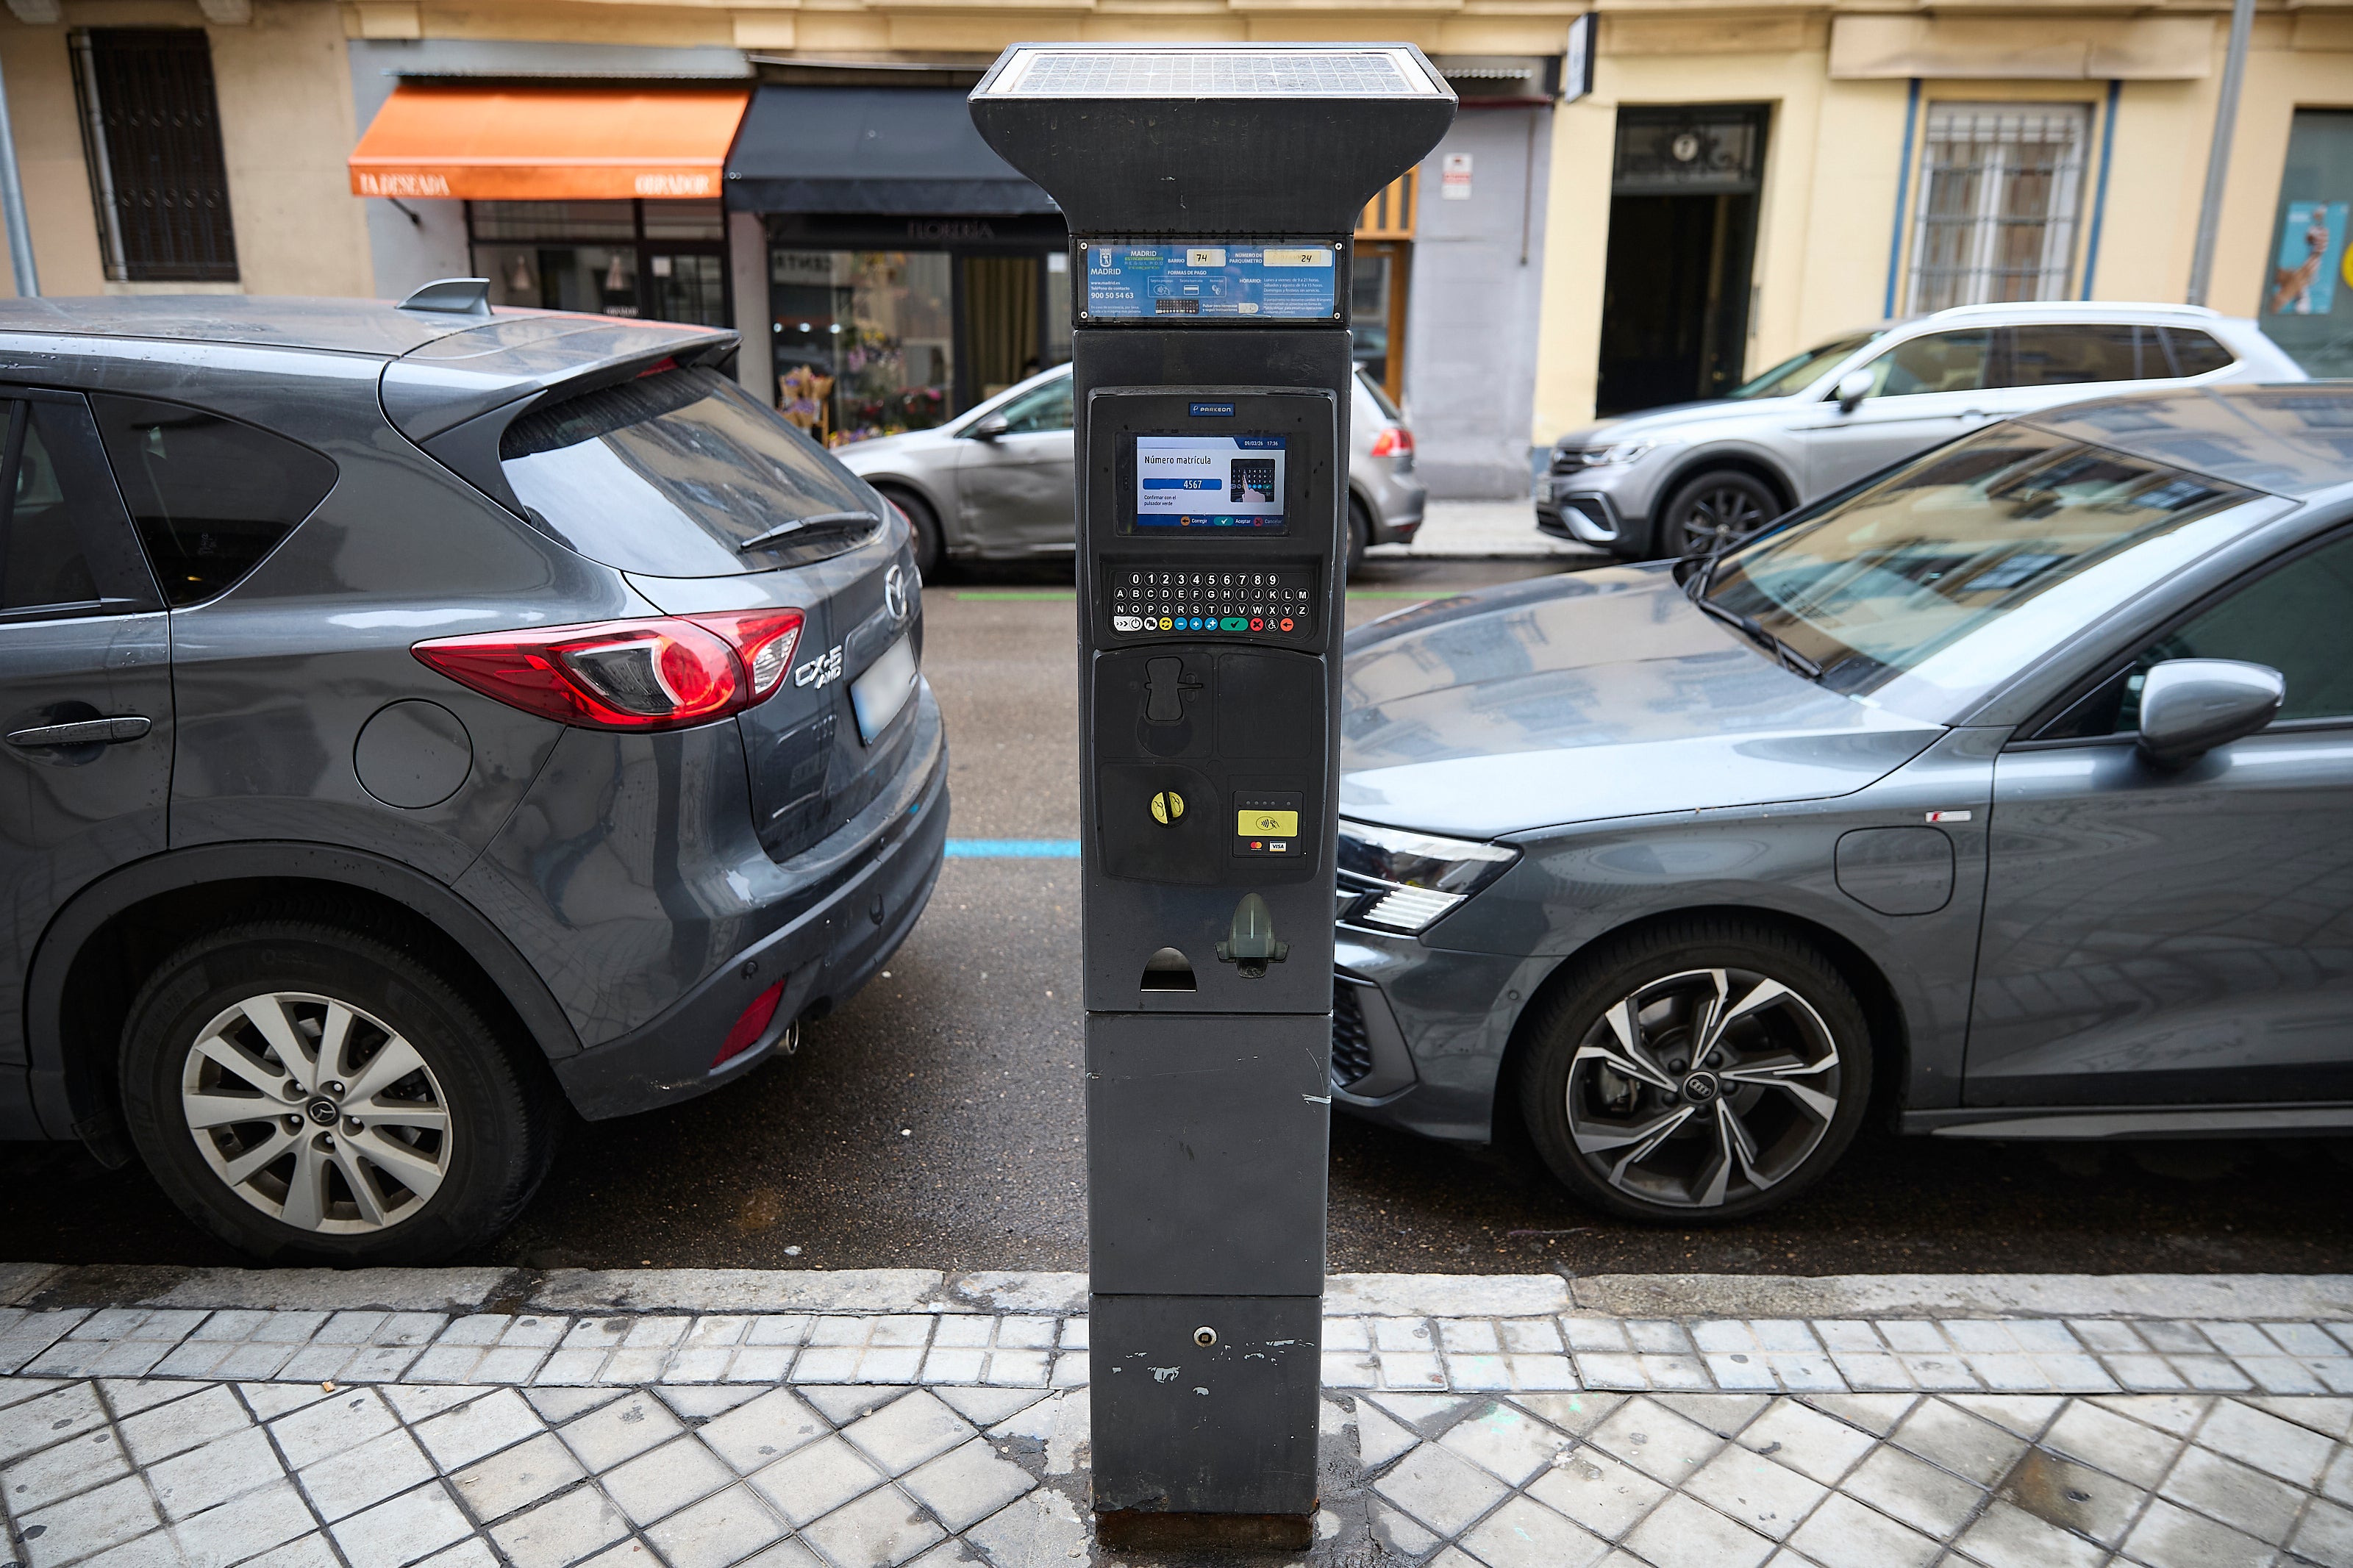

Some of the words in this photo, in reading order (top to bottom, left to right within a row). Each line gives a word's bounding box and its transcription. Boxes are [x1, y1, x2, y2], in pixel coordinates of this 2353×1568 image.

[1196, 254, 1207, 262] 74
[1302, 254, 1312, 262] 24
[1144, 456, 1174, 464] Número
[1176, 456, 1211, 464] matrícula
[1183, 481, 1202, 489] 4567
[1133, 574, 1139, 583] 0
[1149, 573, 1153, 584] 1
[1163, 575, 1169, 584] 2
[1178, 575, 1184, 584] 3
[1192, 575, 1200, 584] 4
[1209, 575, 1215, 585] 5
[1224, 575, 1231, 585] 6
[1240, 575, 1246, 585] 7
[1254, 575, 1260, 585] 8
[1269, 575, 1277, 585] 9
[1178, 590, 1184, 598] E
[1255, 591, 1260, 599] J
[1270, 591, 1276, 599] K
[1285, 591, 1291, 599] L
[1161, 605, 1170, 613] Q
[1178, 605, 1184, 613] R
[1193, 605, 1199, 613] S
[1253, 606, 1262, 615] W
[1270, 606, 1275, 614] X
[795, 645, 843, 687] CX-5
